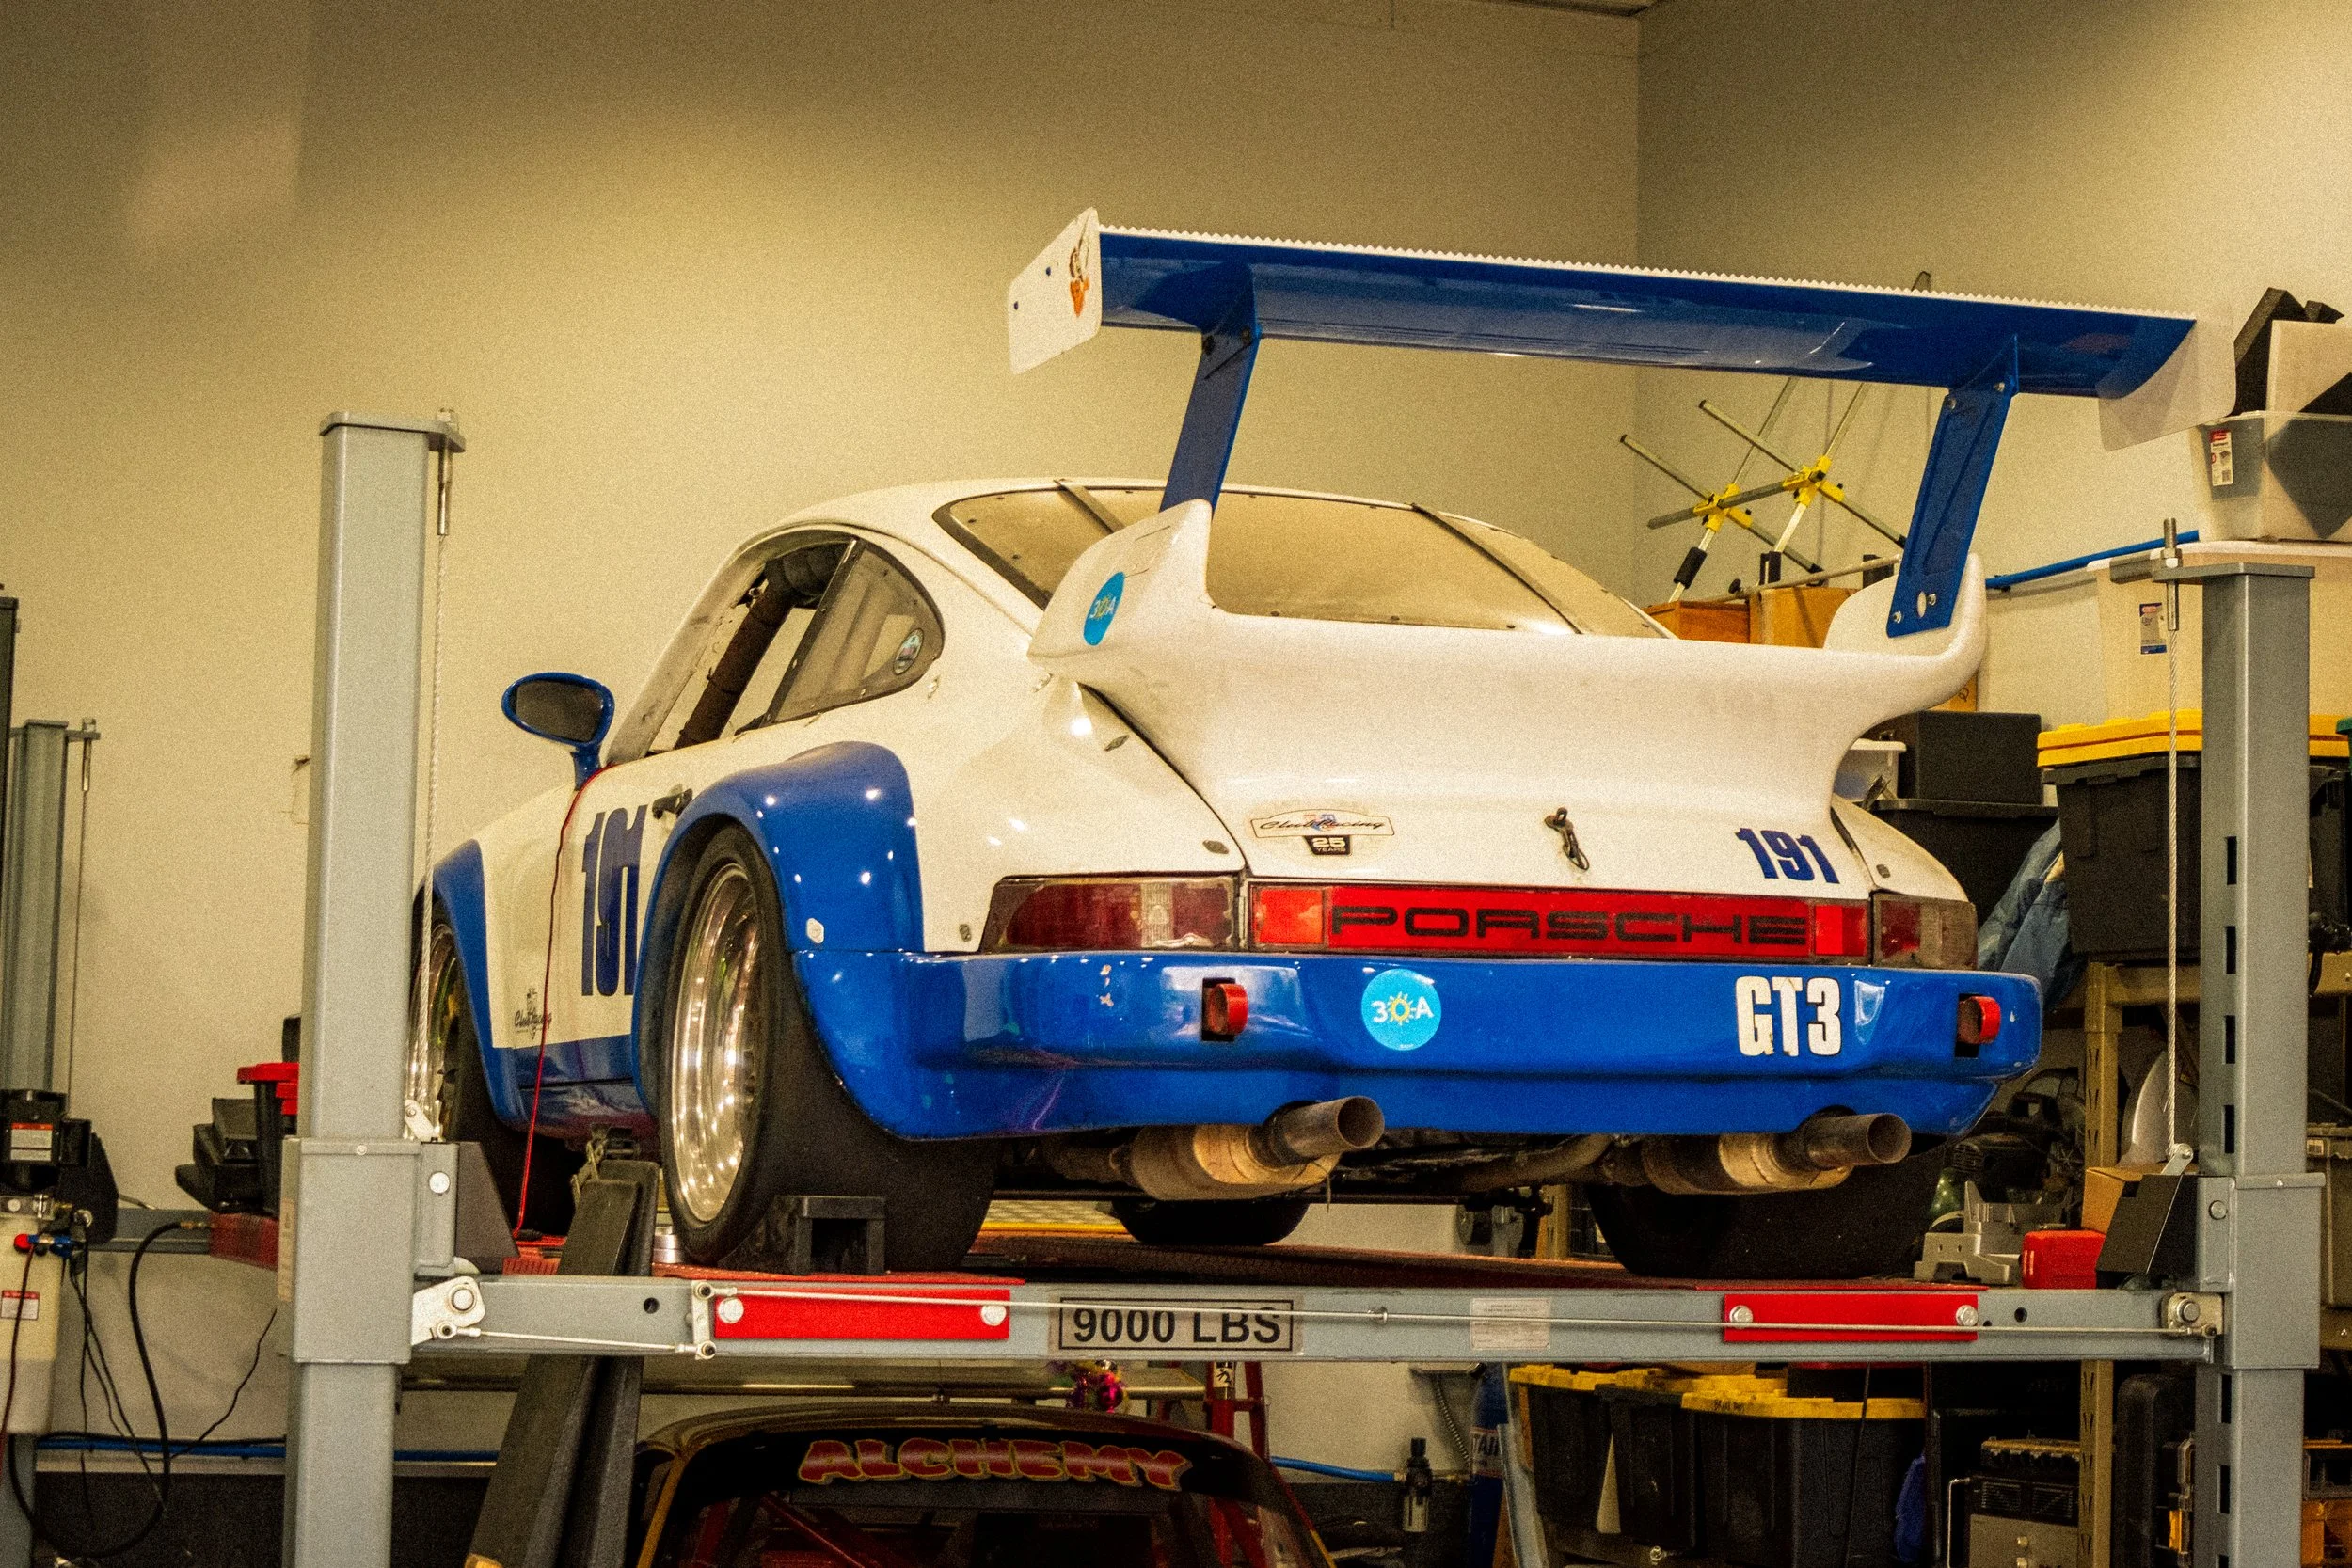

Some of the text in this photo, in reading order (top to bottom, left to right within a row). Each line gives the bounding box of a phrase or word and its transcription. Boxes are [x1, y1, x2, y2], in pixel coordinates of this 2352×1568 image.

[1311, 837, 1346, 847] 25
[1318, 818, 1385, 830] Racing
[1734, 827, 1840, 884] 191
[581, 804, 648, 996] 191
[1331, 906, 1806, 946] PORSCHE
[1735, 975, 1842, 1057] GT3
[1073, 1307, 1280, 1344] 9000 LBS
[798, 1437, 1193, 1492] ALCHEMY
